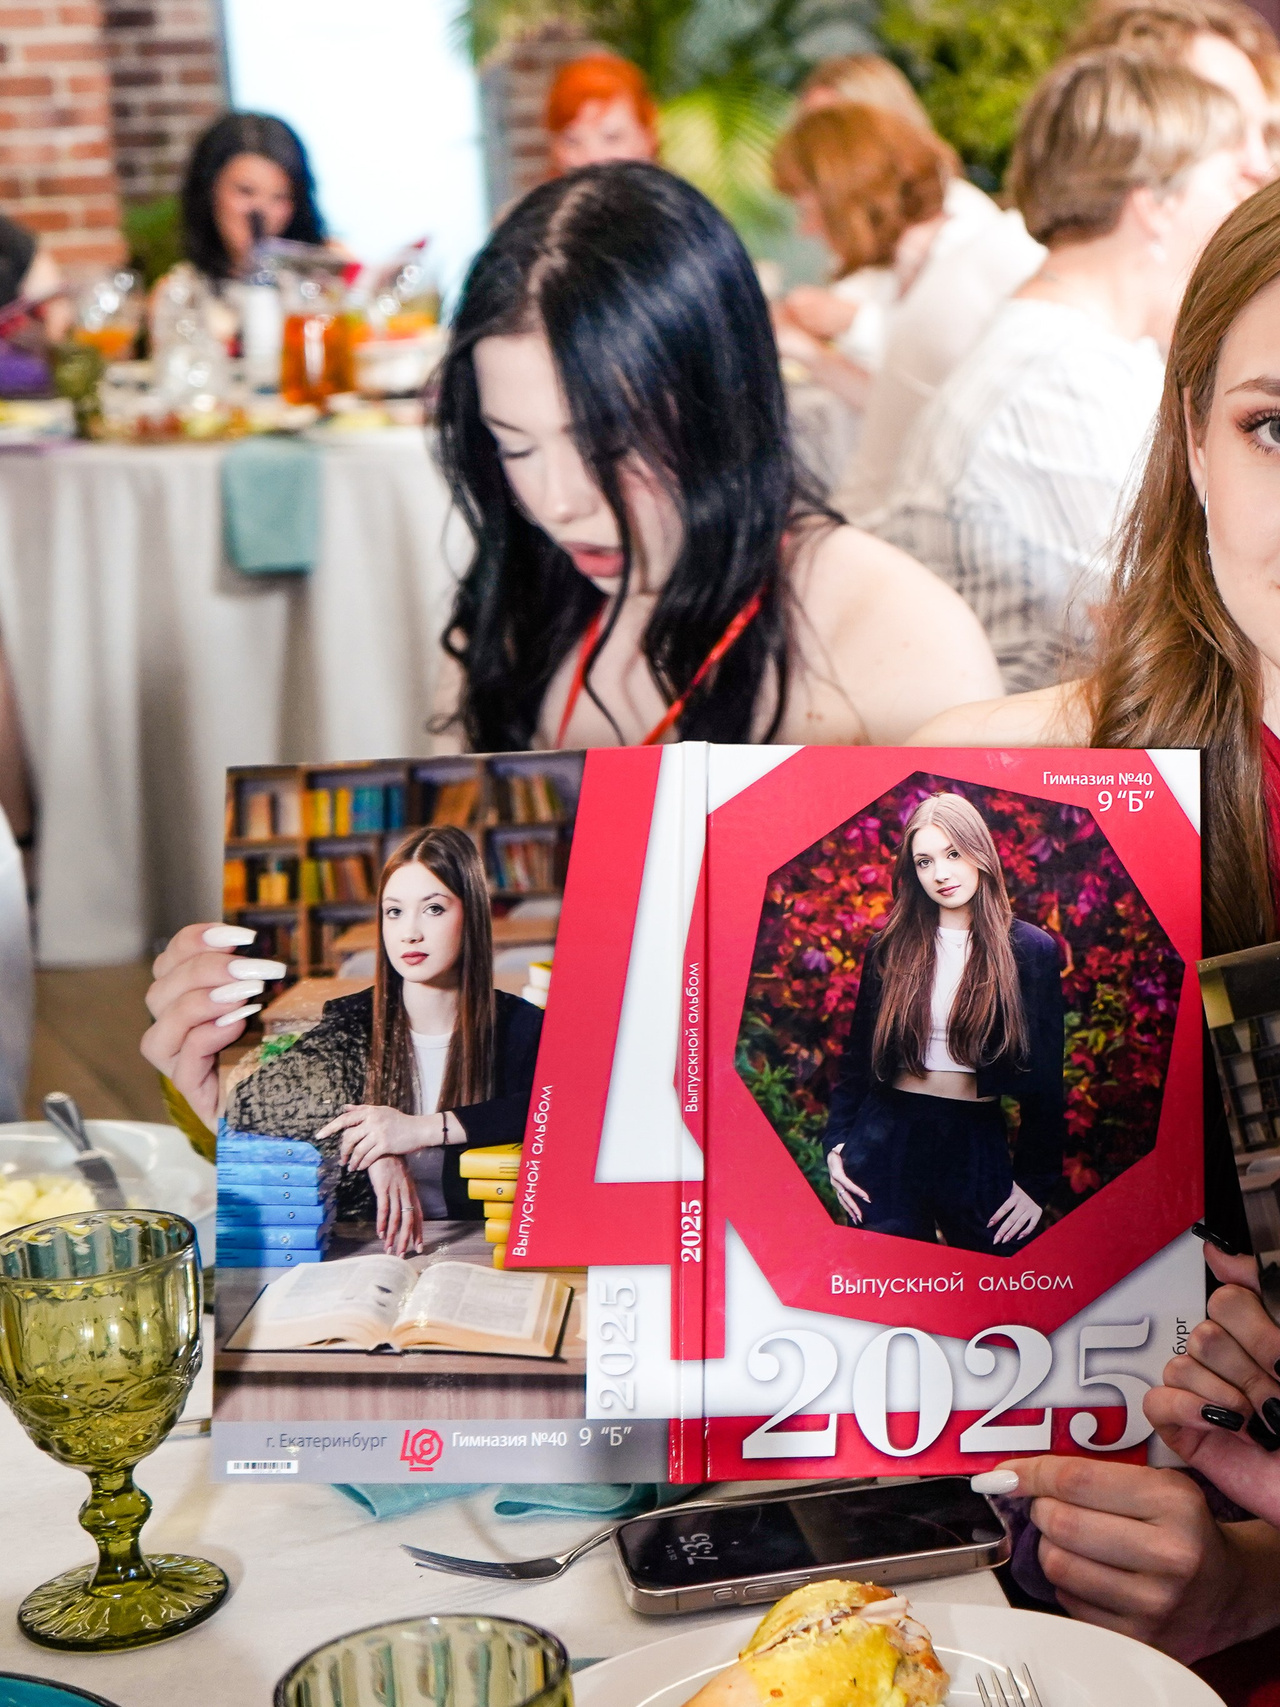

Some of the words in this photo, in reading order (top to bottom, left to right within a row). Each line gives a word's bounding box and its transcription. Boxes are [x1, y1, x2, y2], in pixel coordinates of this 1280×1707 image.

[1042, 771, 1114, 785] Гимназия
[1118, 772, 1153, 786] №40
[1097, 790, 1113, 812] 9
[685, 962, 700, 1024] альбом
[684, 1027, 702, 1113] Выпускной
[511, 1160, 542, 1257] Выпускной
[531, 1085, 553, 1156] альбом
[680, 1199, 702, 1263] 2025
[831, 1271, 964, 1298] Выпускной
[978, 1270, 1074, 1291] альбом
[597, 1277, 637, 1411] 2025
[742, 1324, 1154, 1458] 2025
[279, 1432, 388, 1451] Екатеринбург
[451, 1431, 527, 1447] Гимназия
[531, 1431, 568, 1447] №40
[578, 1427, 592, 1447] 9
[679, 1533, 718, 1566] 7:35
